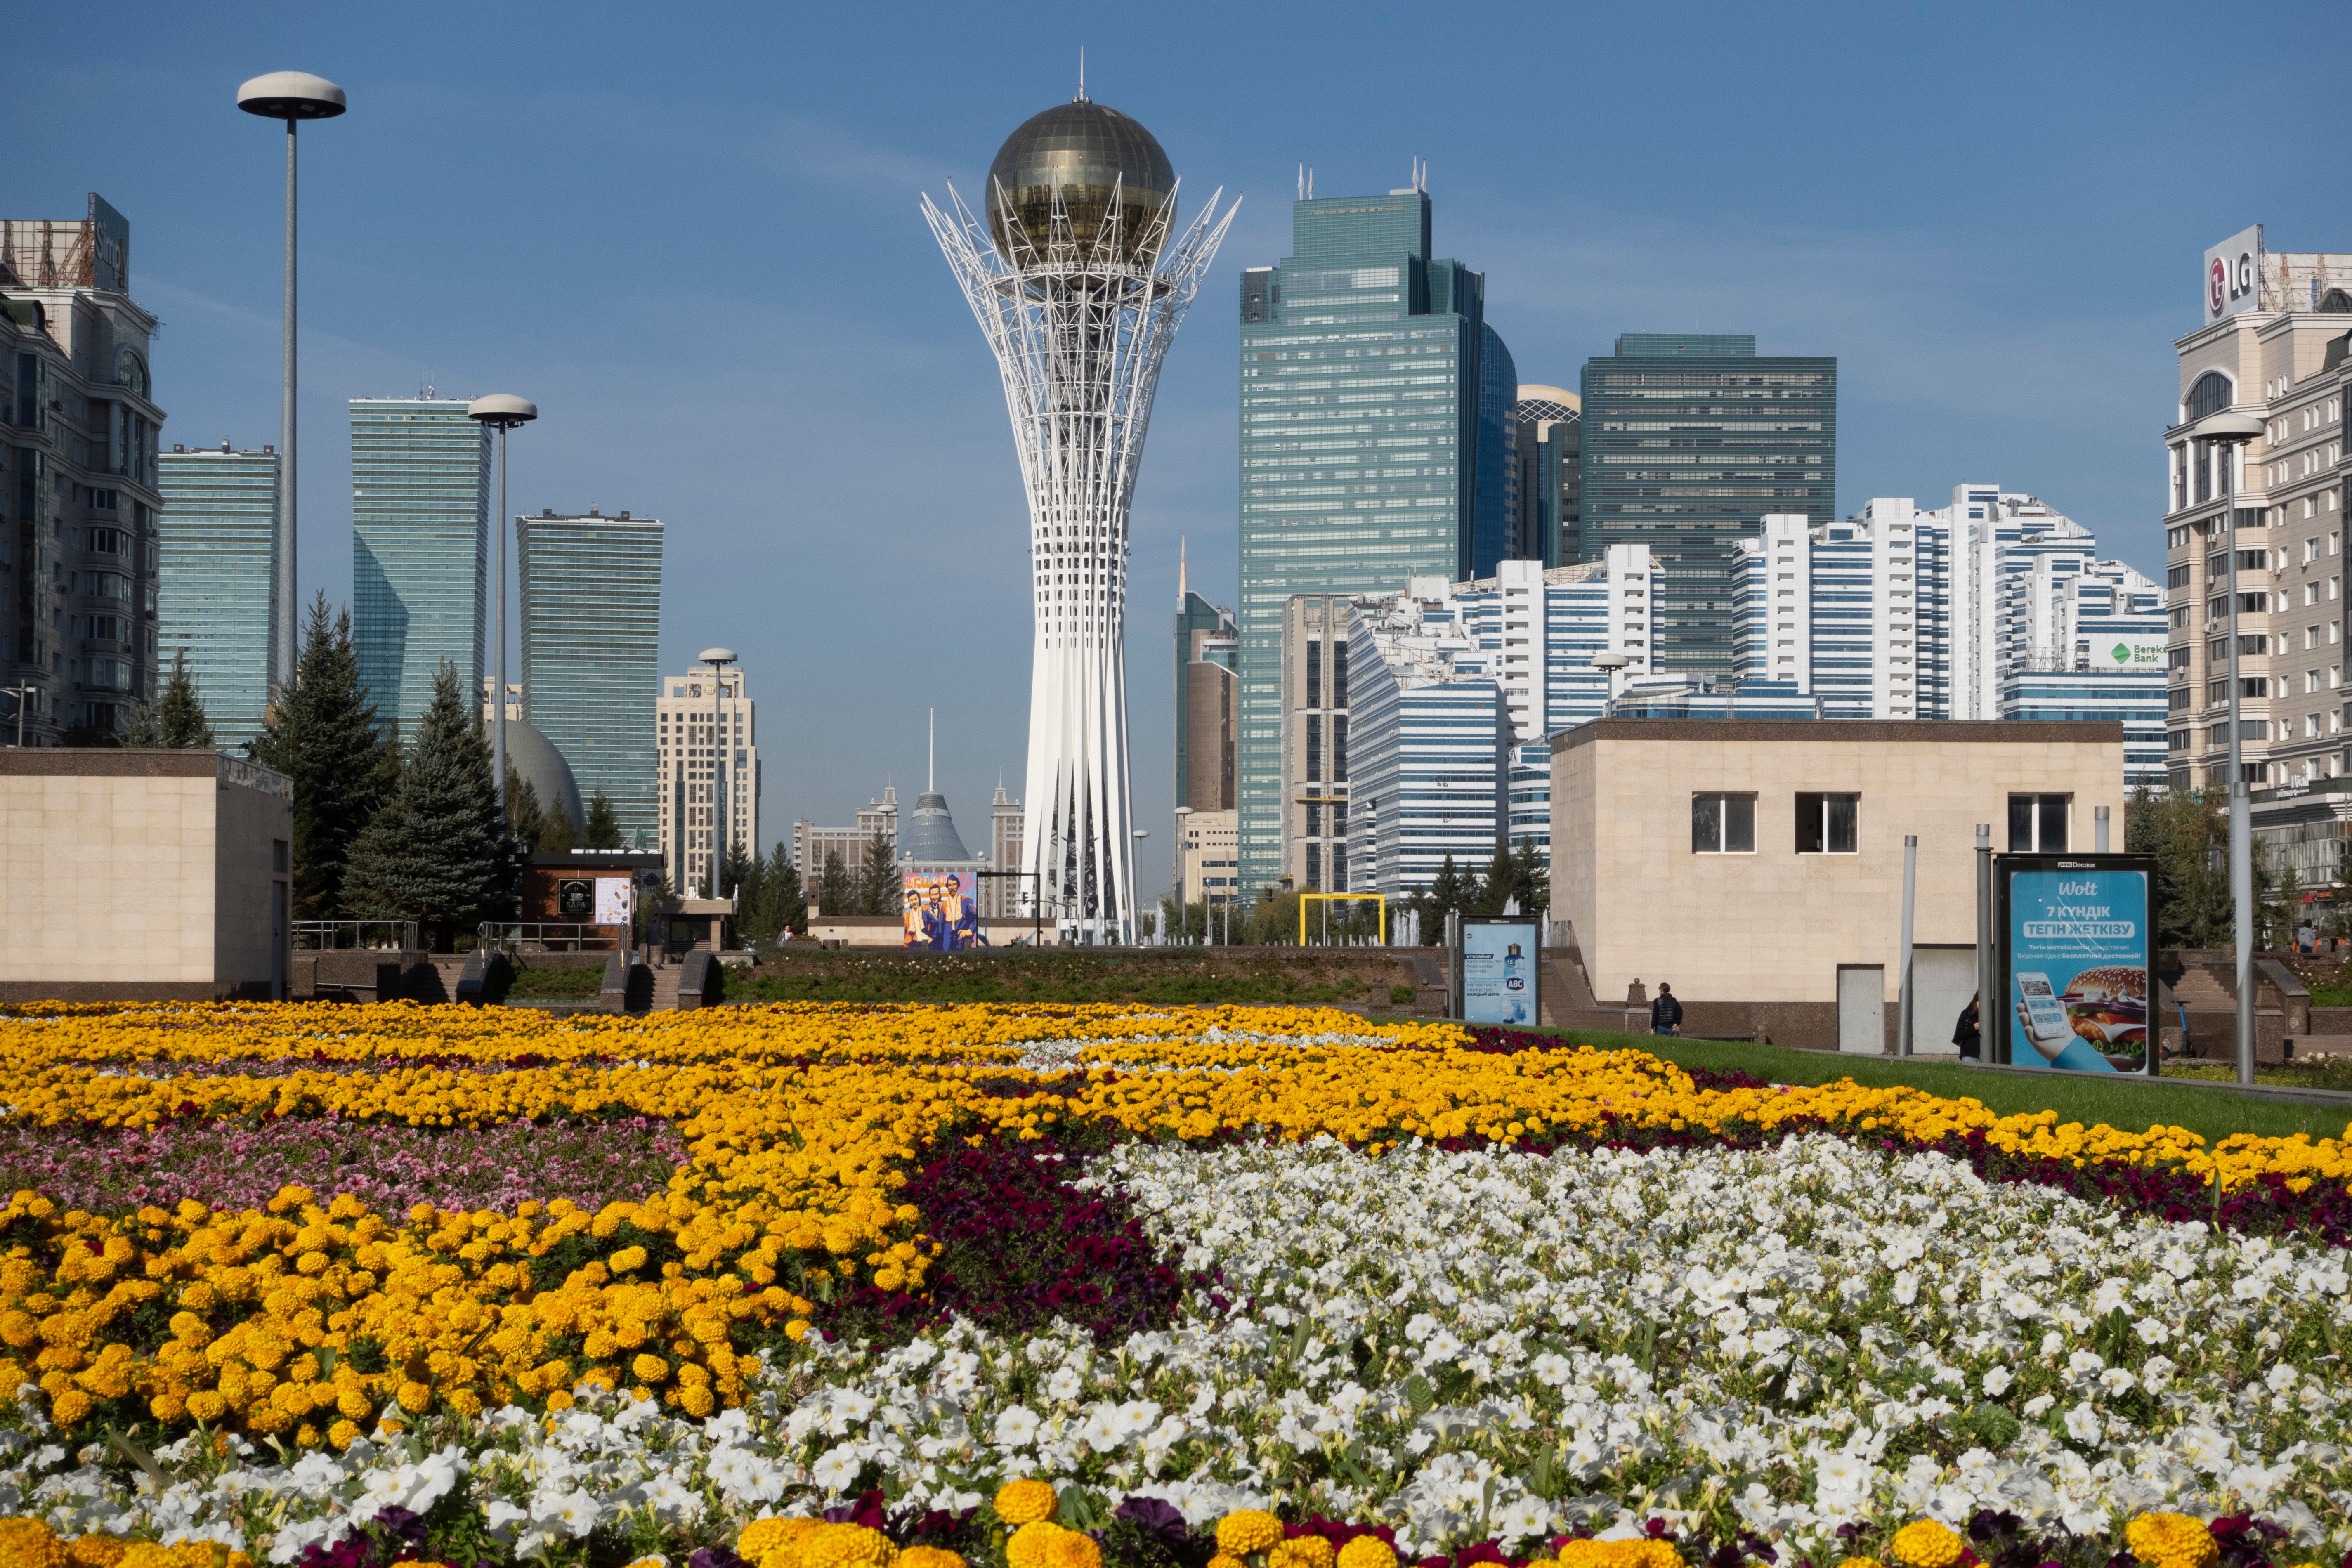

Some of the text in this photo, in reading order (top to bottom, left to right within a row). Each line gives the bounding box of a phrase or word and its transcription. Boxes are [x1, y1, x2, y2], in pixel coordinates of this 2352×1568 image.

[2230, 253, 2251, 300] LG
[2134, 654, 2158, 662] Bank
[2059, 881, 2097, 896] Wolt
[2047, 906, 2055, 917] 7
[2027, 924, 2130, 935] ТЕГІН ЖЕТКІЗУ
